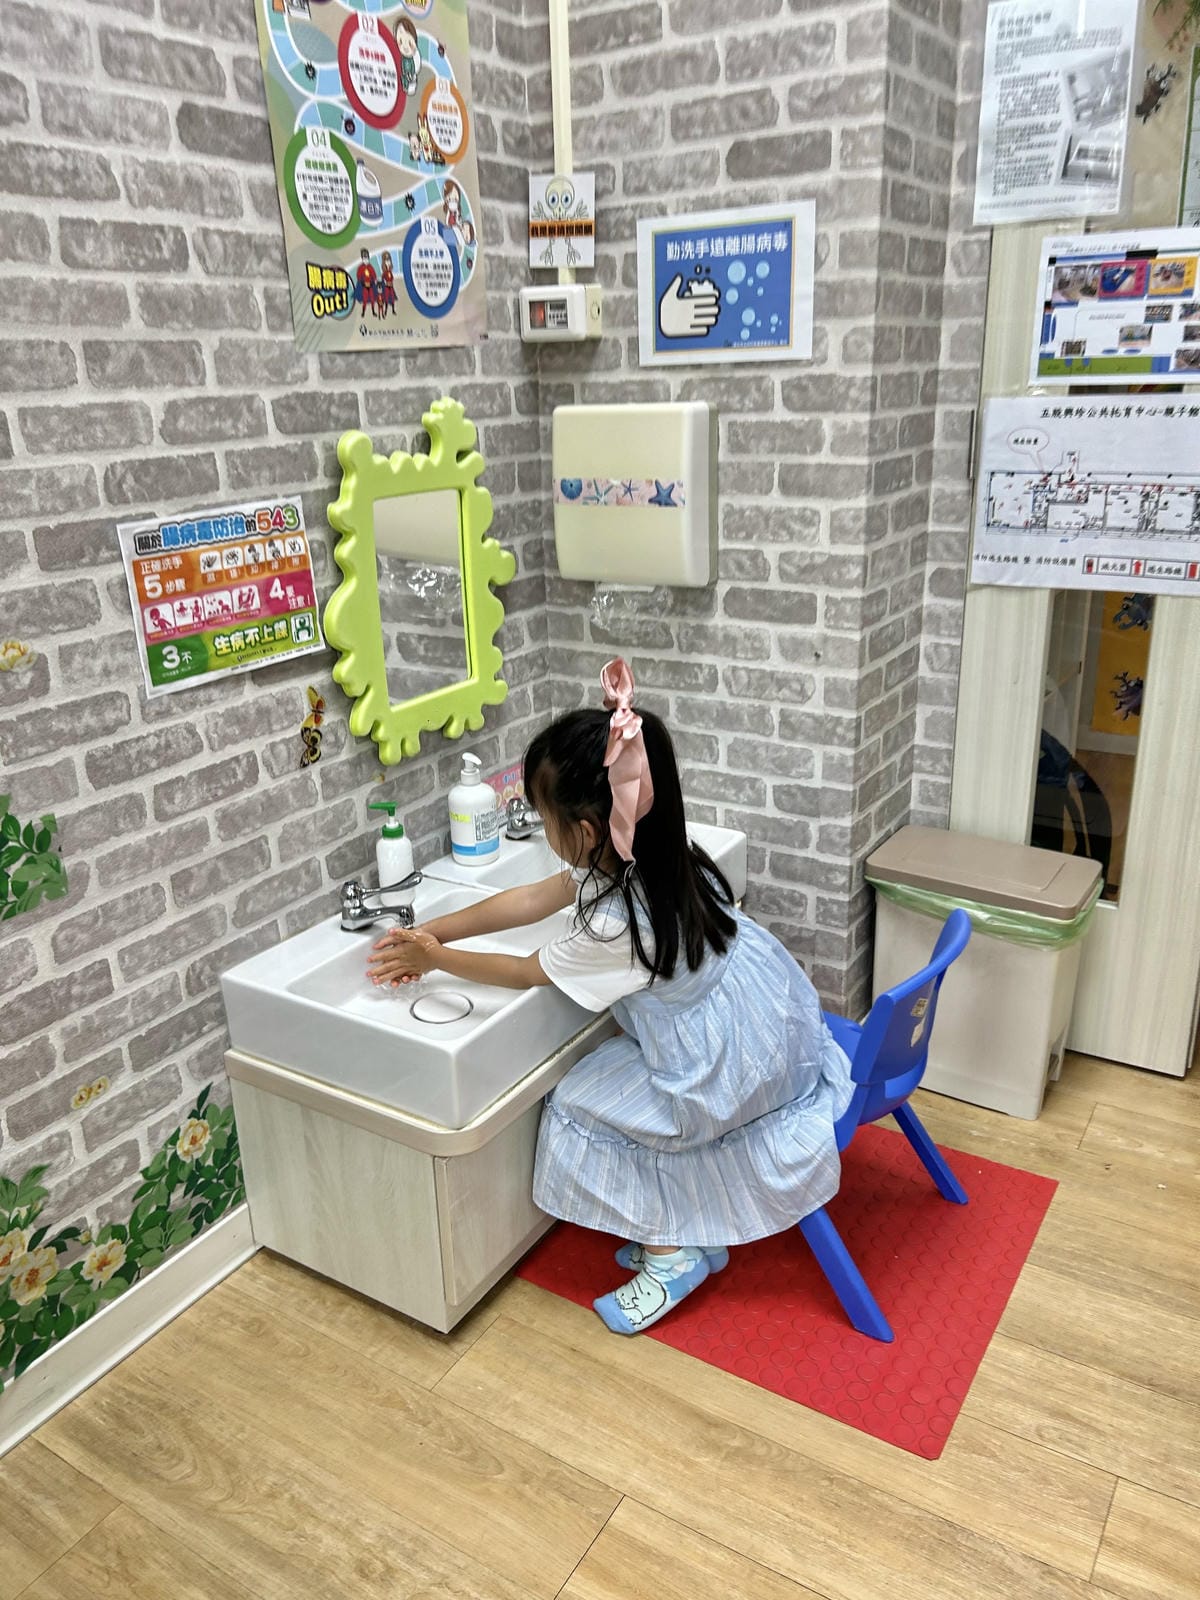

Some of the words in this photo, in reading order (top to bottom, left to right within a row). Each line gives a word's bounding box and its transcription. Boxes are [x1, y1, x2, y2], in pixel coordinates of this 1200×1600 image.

[361, 15, 376, 34] 02
[311, 129, 327, 148] 04
[423, 220, 436, 235] 05
[666, 230, 789, 261] 勤洗手遠離腸病毒
[312, 291, 348, 317] Out!
[213, 620, 289, 656] 生病不上課
